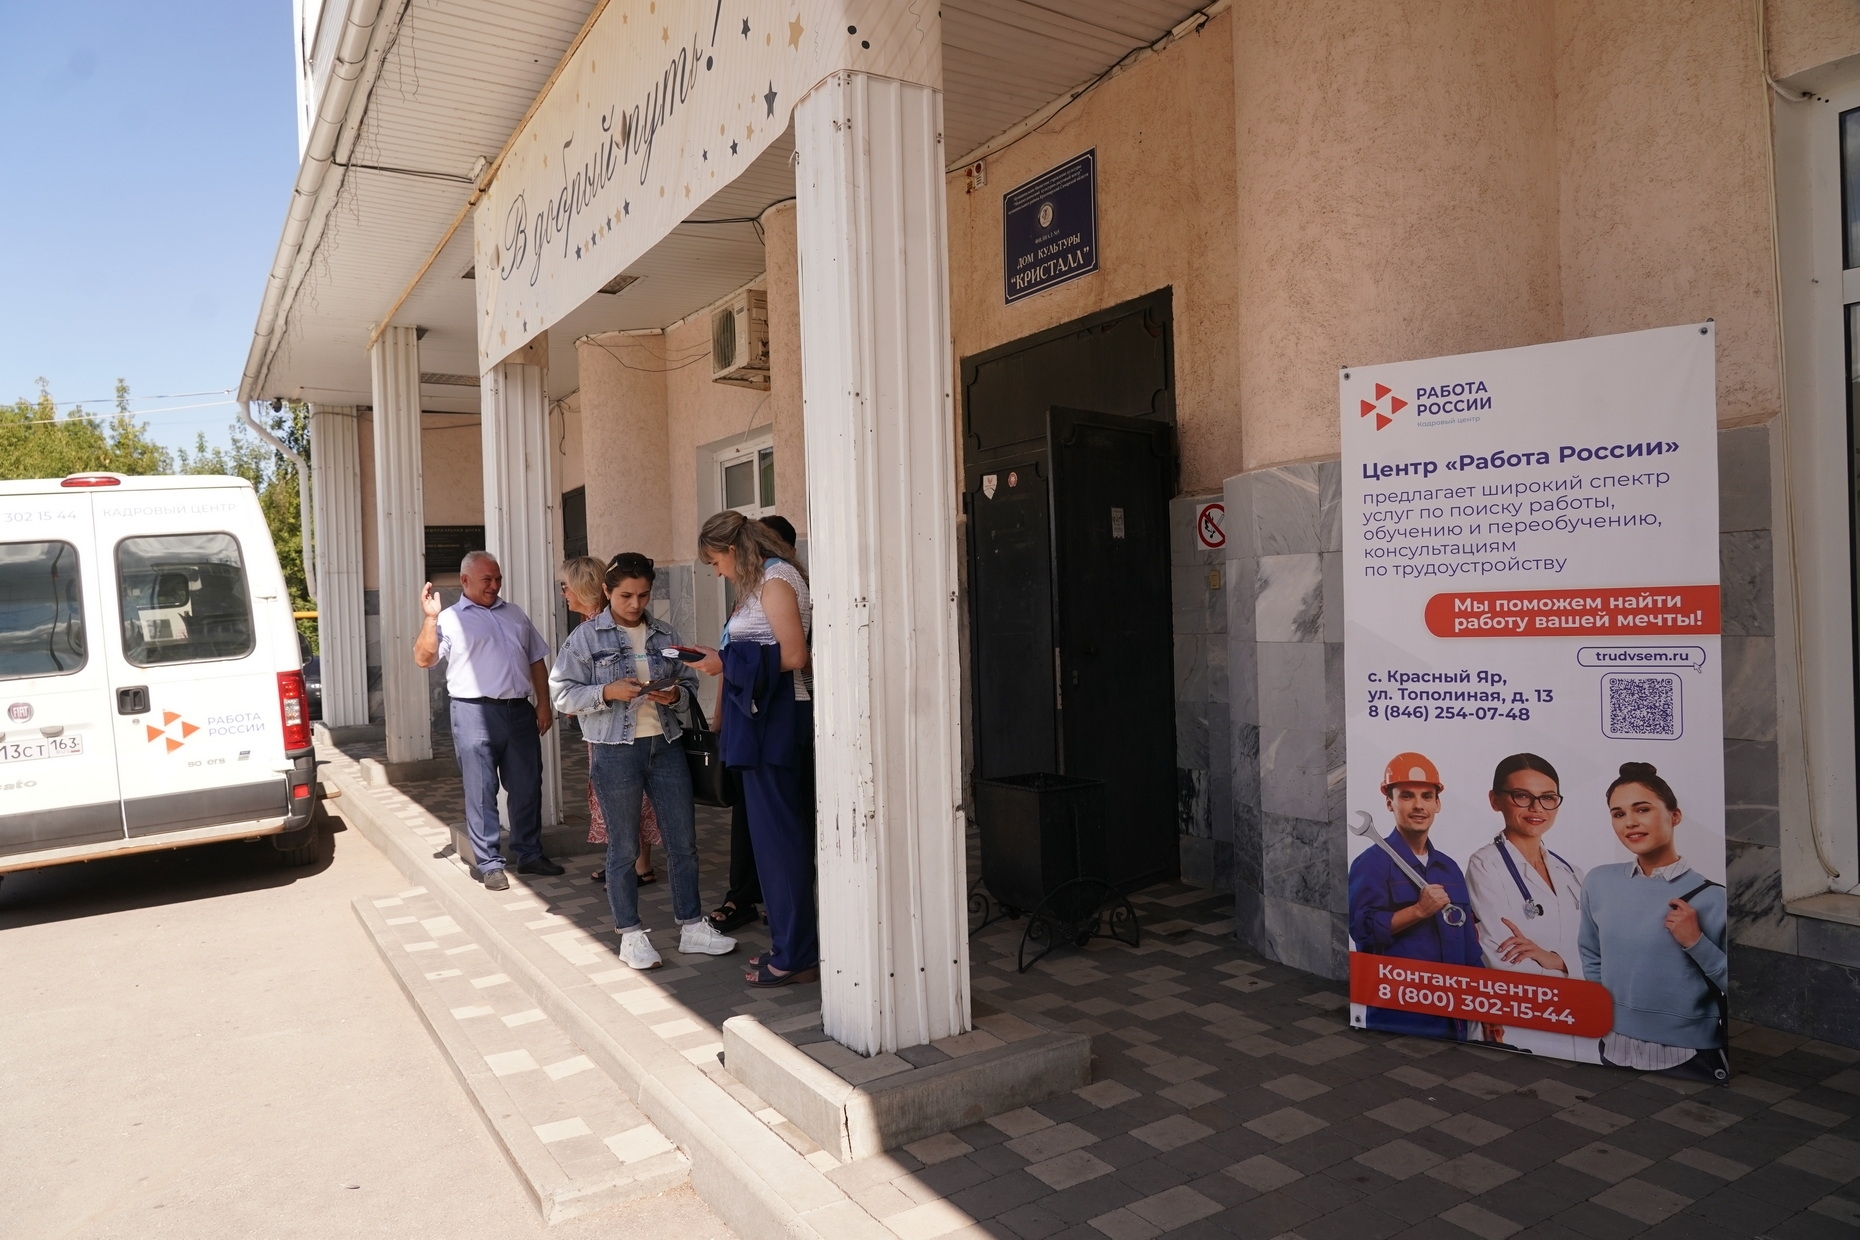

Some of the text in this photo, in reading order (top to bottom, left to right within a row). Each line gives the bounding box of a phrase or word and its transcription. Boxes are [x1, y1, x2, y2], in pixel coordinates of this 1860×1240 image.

[501, 189, 527, 281] В
[530, 104, 617, 287] добрый
[1017, 233, 1081, 270] ДОМ КУЛЬТУРЫ
[1416, 380, 1488, 400] РАБОТА
[1417, 396, 1492, 416] РОССИИ
[1417, 415, 1481, 427] Кадровый центр
[1362, 441, 1680, 481] Центр «Работа России»
[1363, 471, 1670, 507] предлагает широкий спектр
[4, 510, 77, 523] 302 15 44
[103, 503, 237, 518] КАДРОВЫЙ ЦЕНТР
[1362, 494, 1615, 526] услуг по поиску работы,
[1363, 513, 1662, 543] обучению и переобучению,
[1364, 541, 1517, 560] консультациям
[1365, 556, 1567, 578] по трудоустройству
[1454, 592, 1682, 612] Мы поможем найти
[1454, 610, 1703, 633] работу вашей мечты!
[1595, 650, 1690, 662] trudvsem.ru
[1367, 669, 1508, 690] с. Красный Яр,
[1367, 688, 1554, 706] ул. Тополиная, д. 13
[12, 706, 29, 718] FIAT
[207, 712, 262, 725] РАБОТА
[1368, 704, 1531, 722] 8 (846) 254-07-48
[208, 723, 265, 736] РОССИИ
[0, 780, 38, 791] ato
[1378, 963, 1559, 1002] Контакт-центр:
[1378, 982, 1576, 1025] 8 (800) 302-15-44
